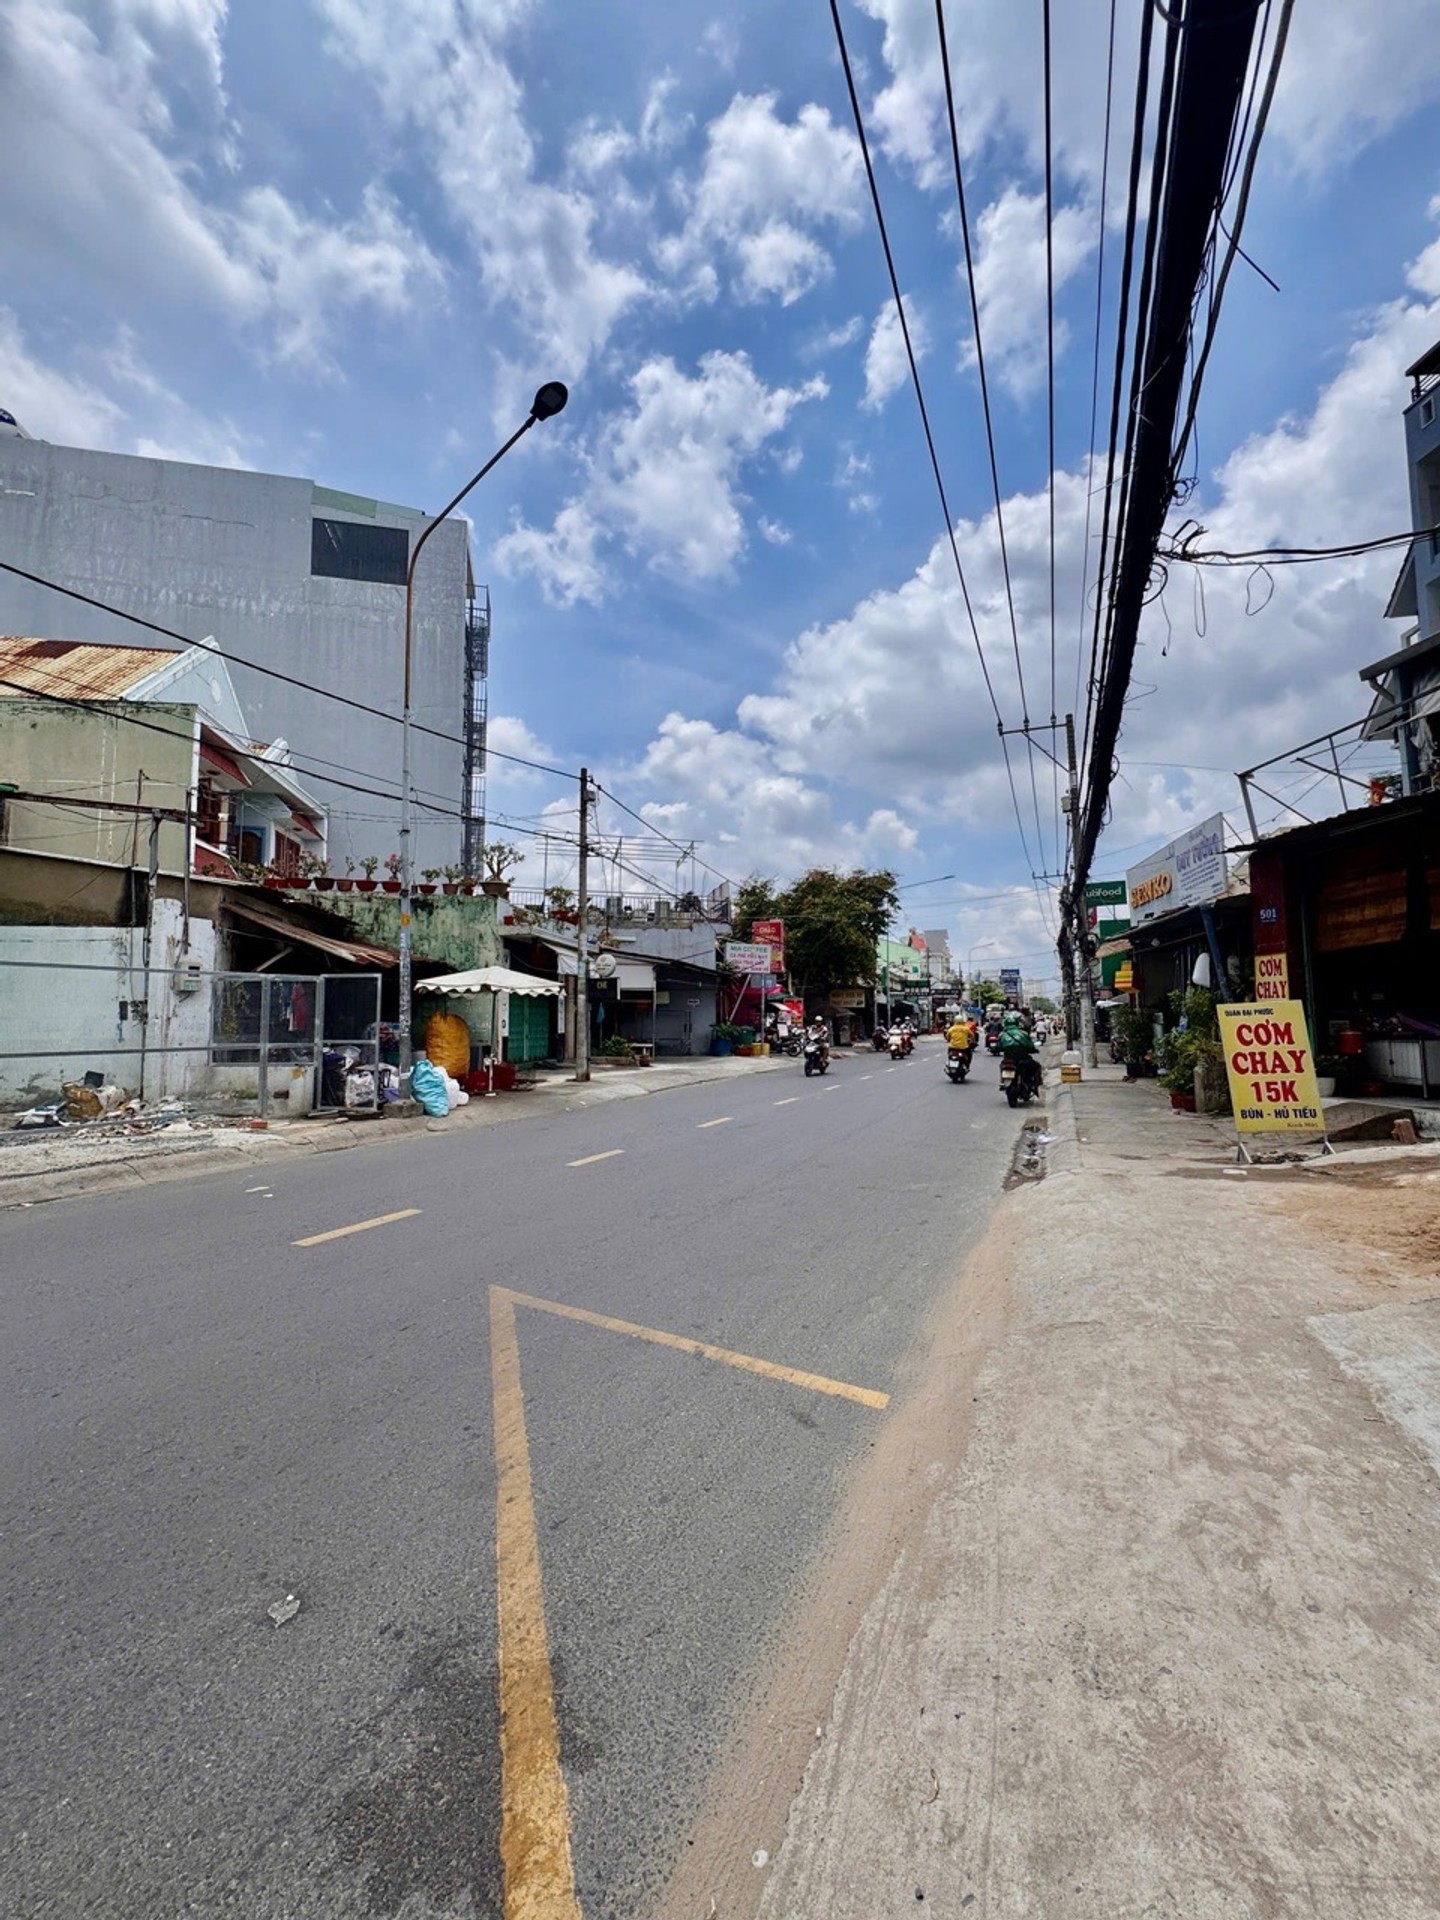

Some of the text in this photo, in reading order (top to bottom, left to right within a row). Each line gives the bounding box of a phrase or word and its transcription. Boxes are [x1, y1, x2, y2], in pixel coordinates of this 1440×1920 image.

[1085, 886, 1121, 897] utifood
[1260, 908, 1277, 919] 501
[1258, 956, 1283, 977] CƠM
[1256, 981, 1287, 998] CHAY
[1236, 1018, 1296, 1046] CƠM
[1231, 1050, 1306, 1075] CHAY
[1250, 1080, 1300, 1103] 15K
[1241, 1106, 1264, 1119] BÚN
[1274, 1105, 1289, 1119] HỦ
